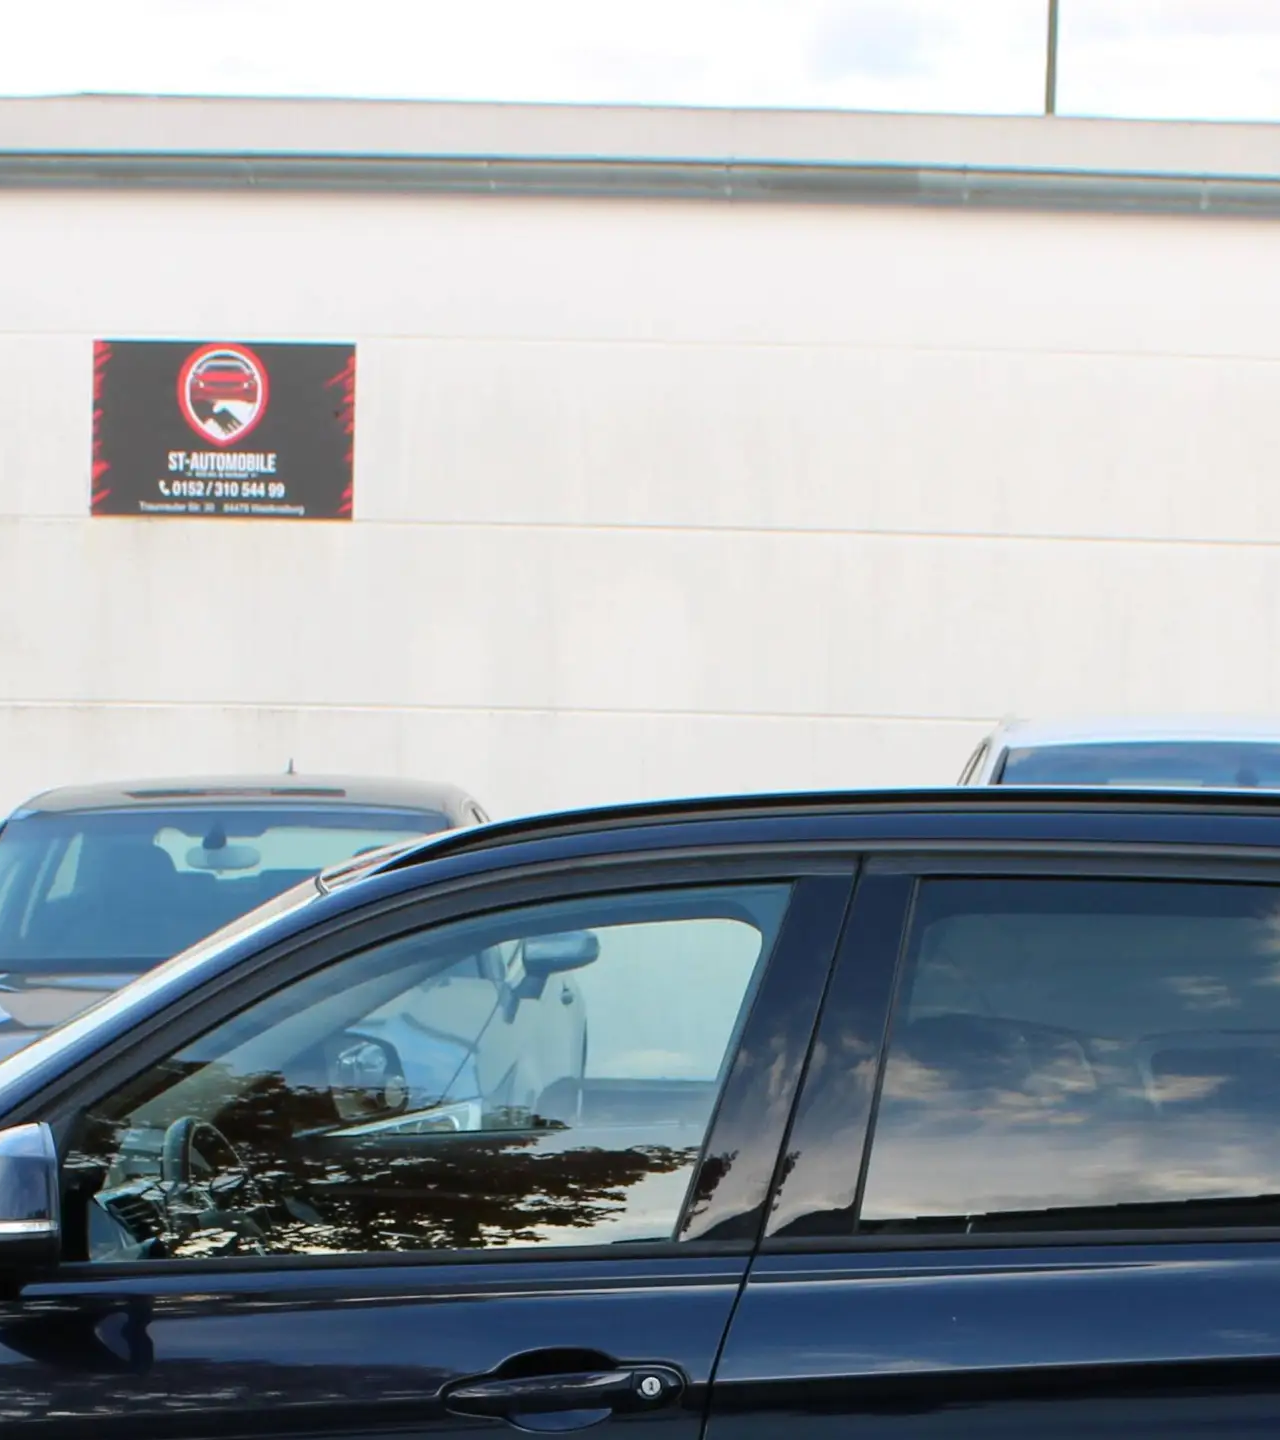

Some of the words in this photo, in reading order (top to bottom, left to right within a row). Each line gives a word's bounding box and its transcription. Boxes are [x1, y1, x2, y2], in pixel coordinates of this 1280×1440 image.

[168, 451, 277, 472] ST-AUTOMOBILE
[172, 480, 204, 496] 0152
[214, 481, 239, 497] 310
[241, 482, 265, 498] 544
[268, 482, 285, 498] 99
